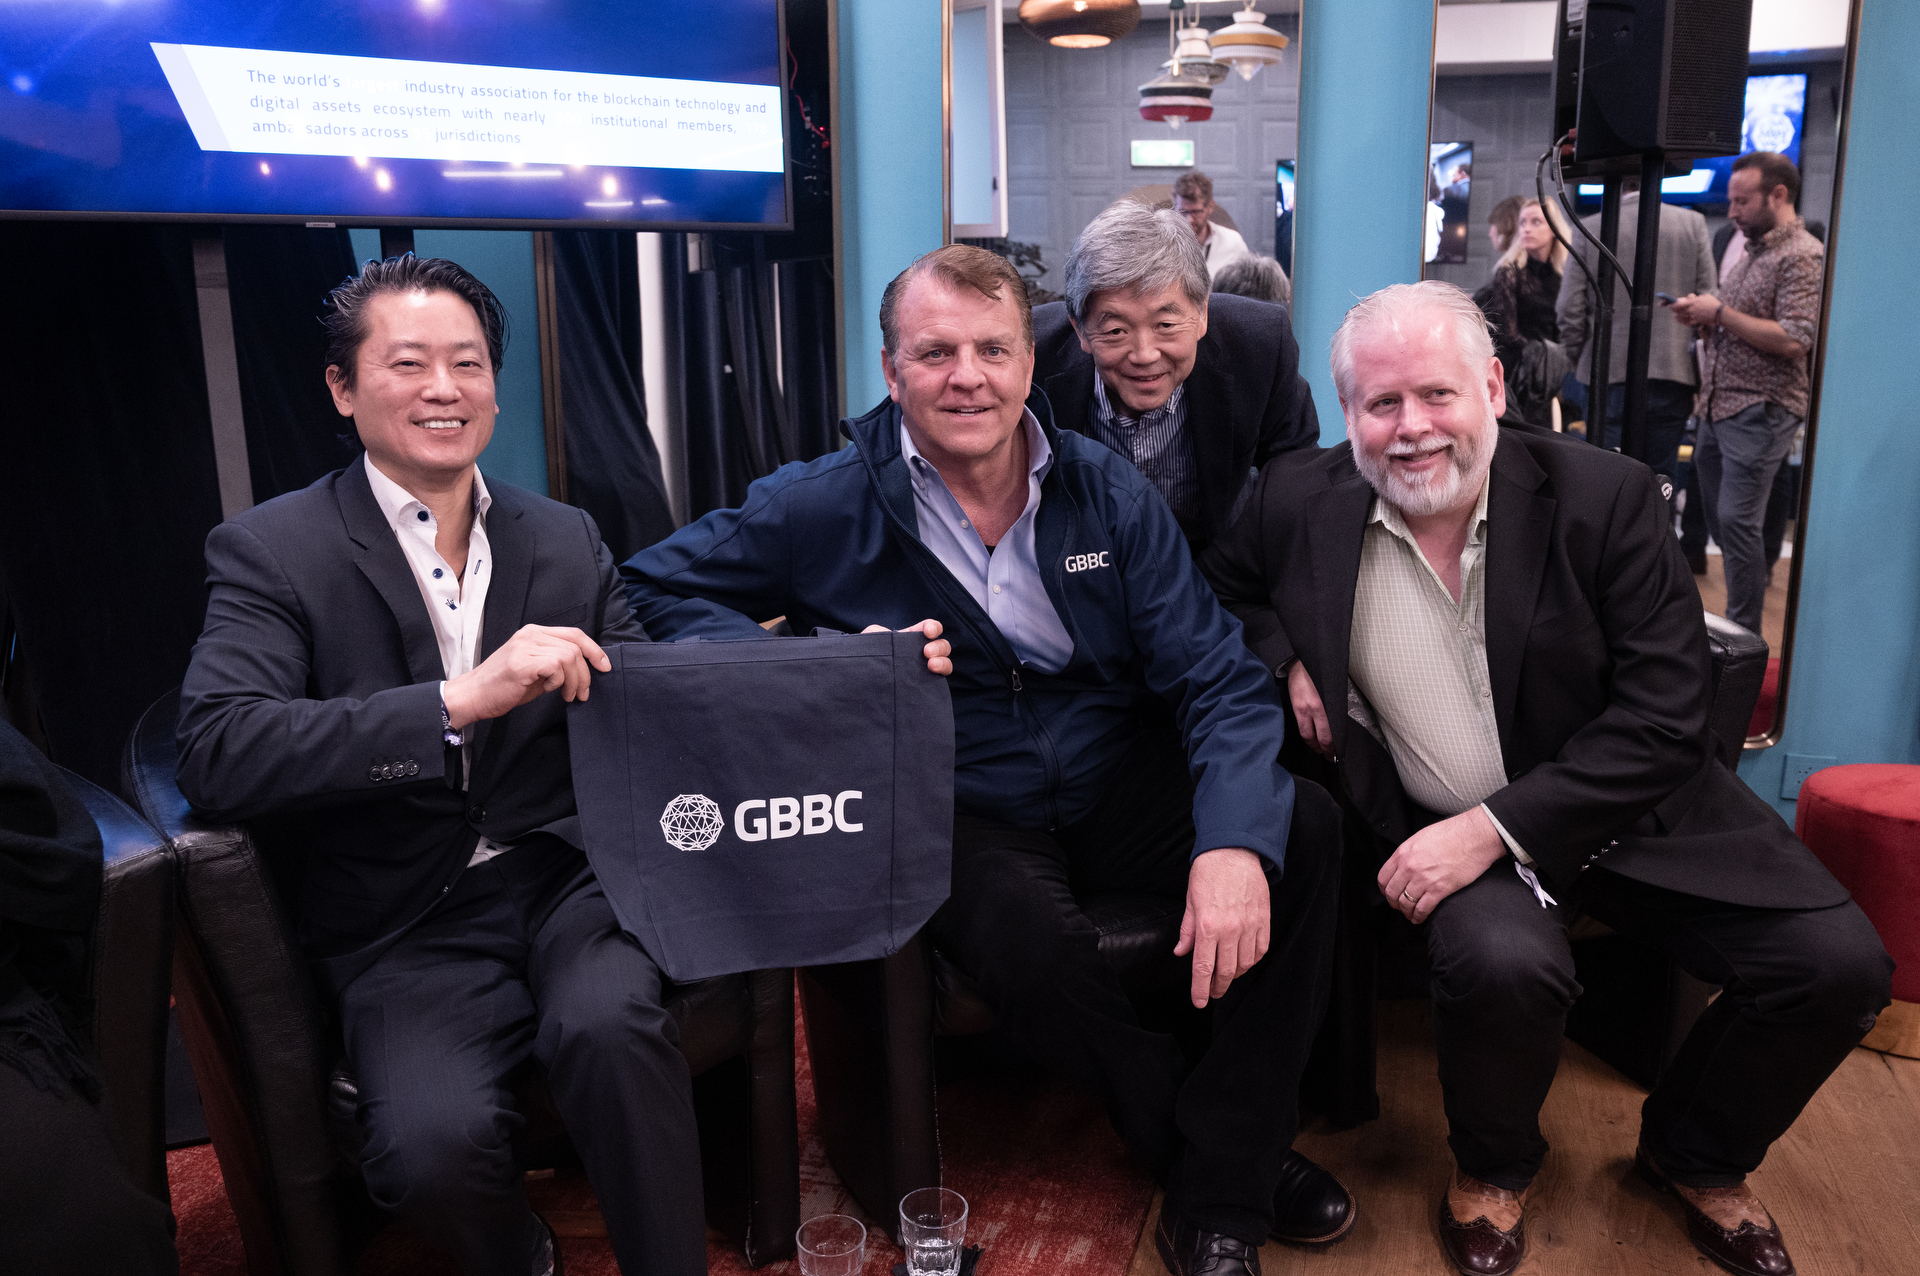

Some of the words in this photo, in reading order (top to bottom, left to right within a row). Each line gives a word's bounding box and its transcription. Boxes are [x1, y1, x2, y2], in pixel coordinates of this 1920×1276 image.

[247, 69, 276, 84] The
[283, 73, 341, 88] world's
[404, 79, 465, 98] industry
[471, 86, 548, 100] association
[553, 88, 572, 102] for
[577, 91, 598, 104] the
[603, 92, 671, 108] blockchain
[675, 97, 741, 115] technology
[745, 102, 766, 114] and
[250, 94, 300, 112] digital
[312, 100, 361, 113] assets
[373, 104, 451, 119] ecosystem
[462, 107, 493, 120] with
[504, 110, 546, 125] nearly
[591, 113, 668, 129] institutional
[677, 120, 737, 134] members,
[361, 126, 409, 139] across
[435, 127, 521, 144] jurisdictions
[1065, 551, 1110, 573] GBBC
[734, 790, 864, 842] GBBC
